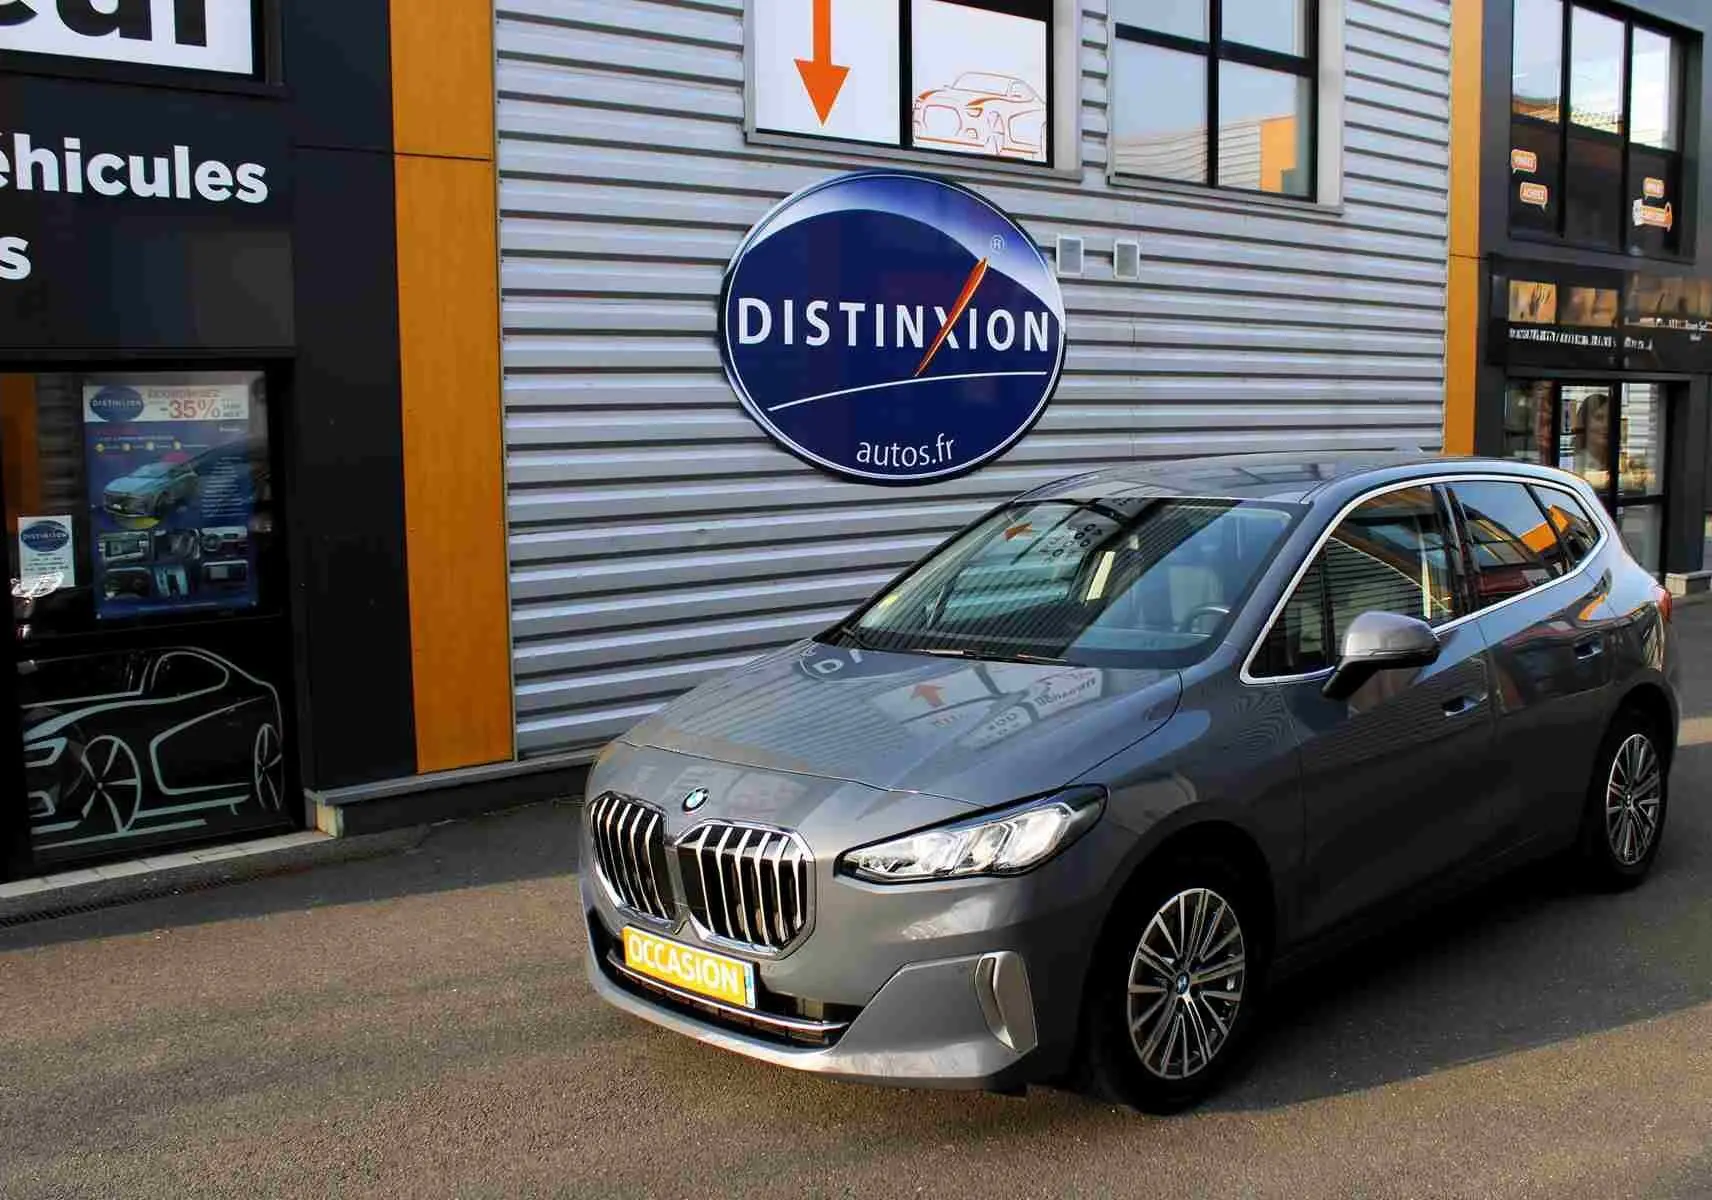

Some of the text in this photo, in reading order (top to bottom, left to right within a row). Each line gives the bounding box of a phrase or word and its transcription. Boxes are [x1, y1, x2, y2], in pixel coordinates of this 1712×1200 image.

[0, 132, 268, 204] hicules
[737, 297, 1049, 352] DISTINXION
[856, 432, 955, 468] autos.fr
[628, 936, 738, 994] OCCASION
